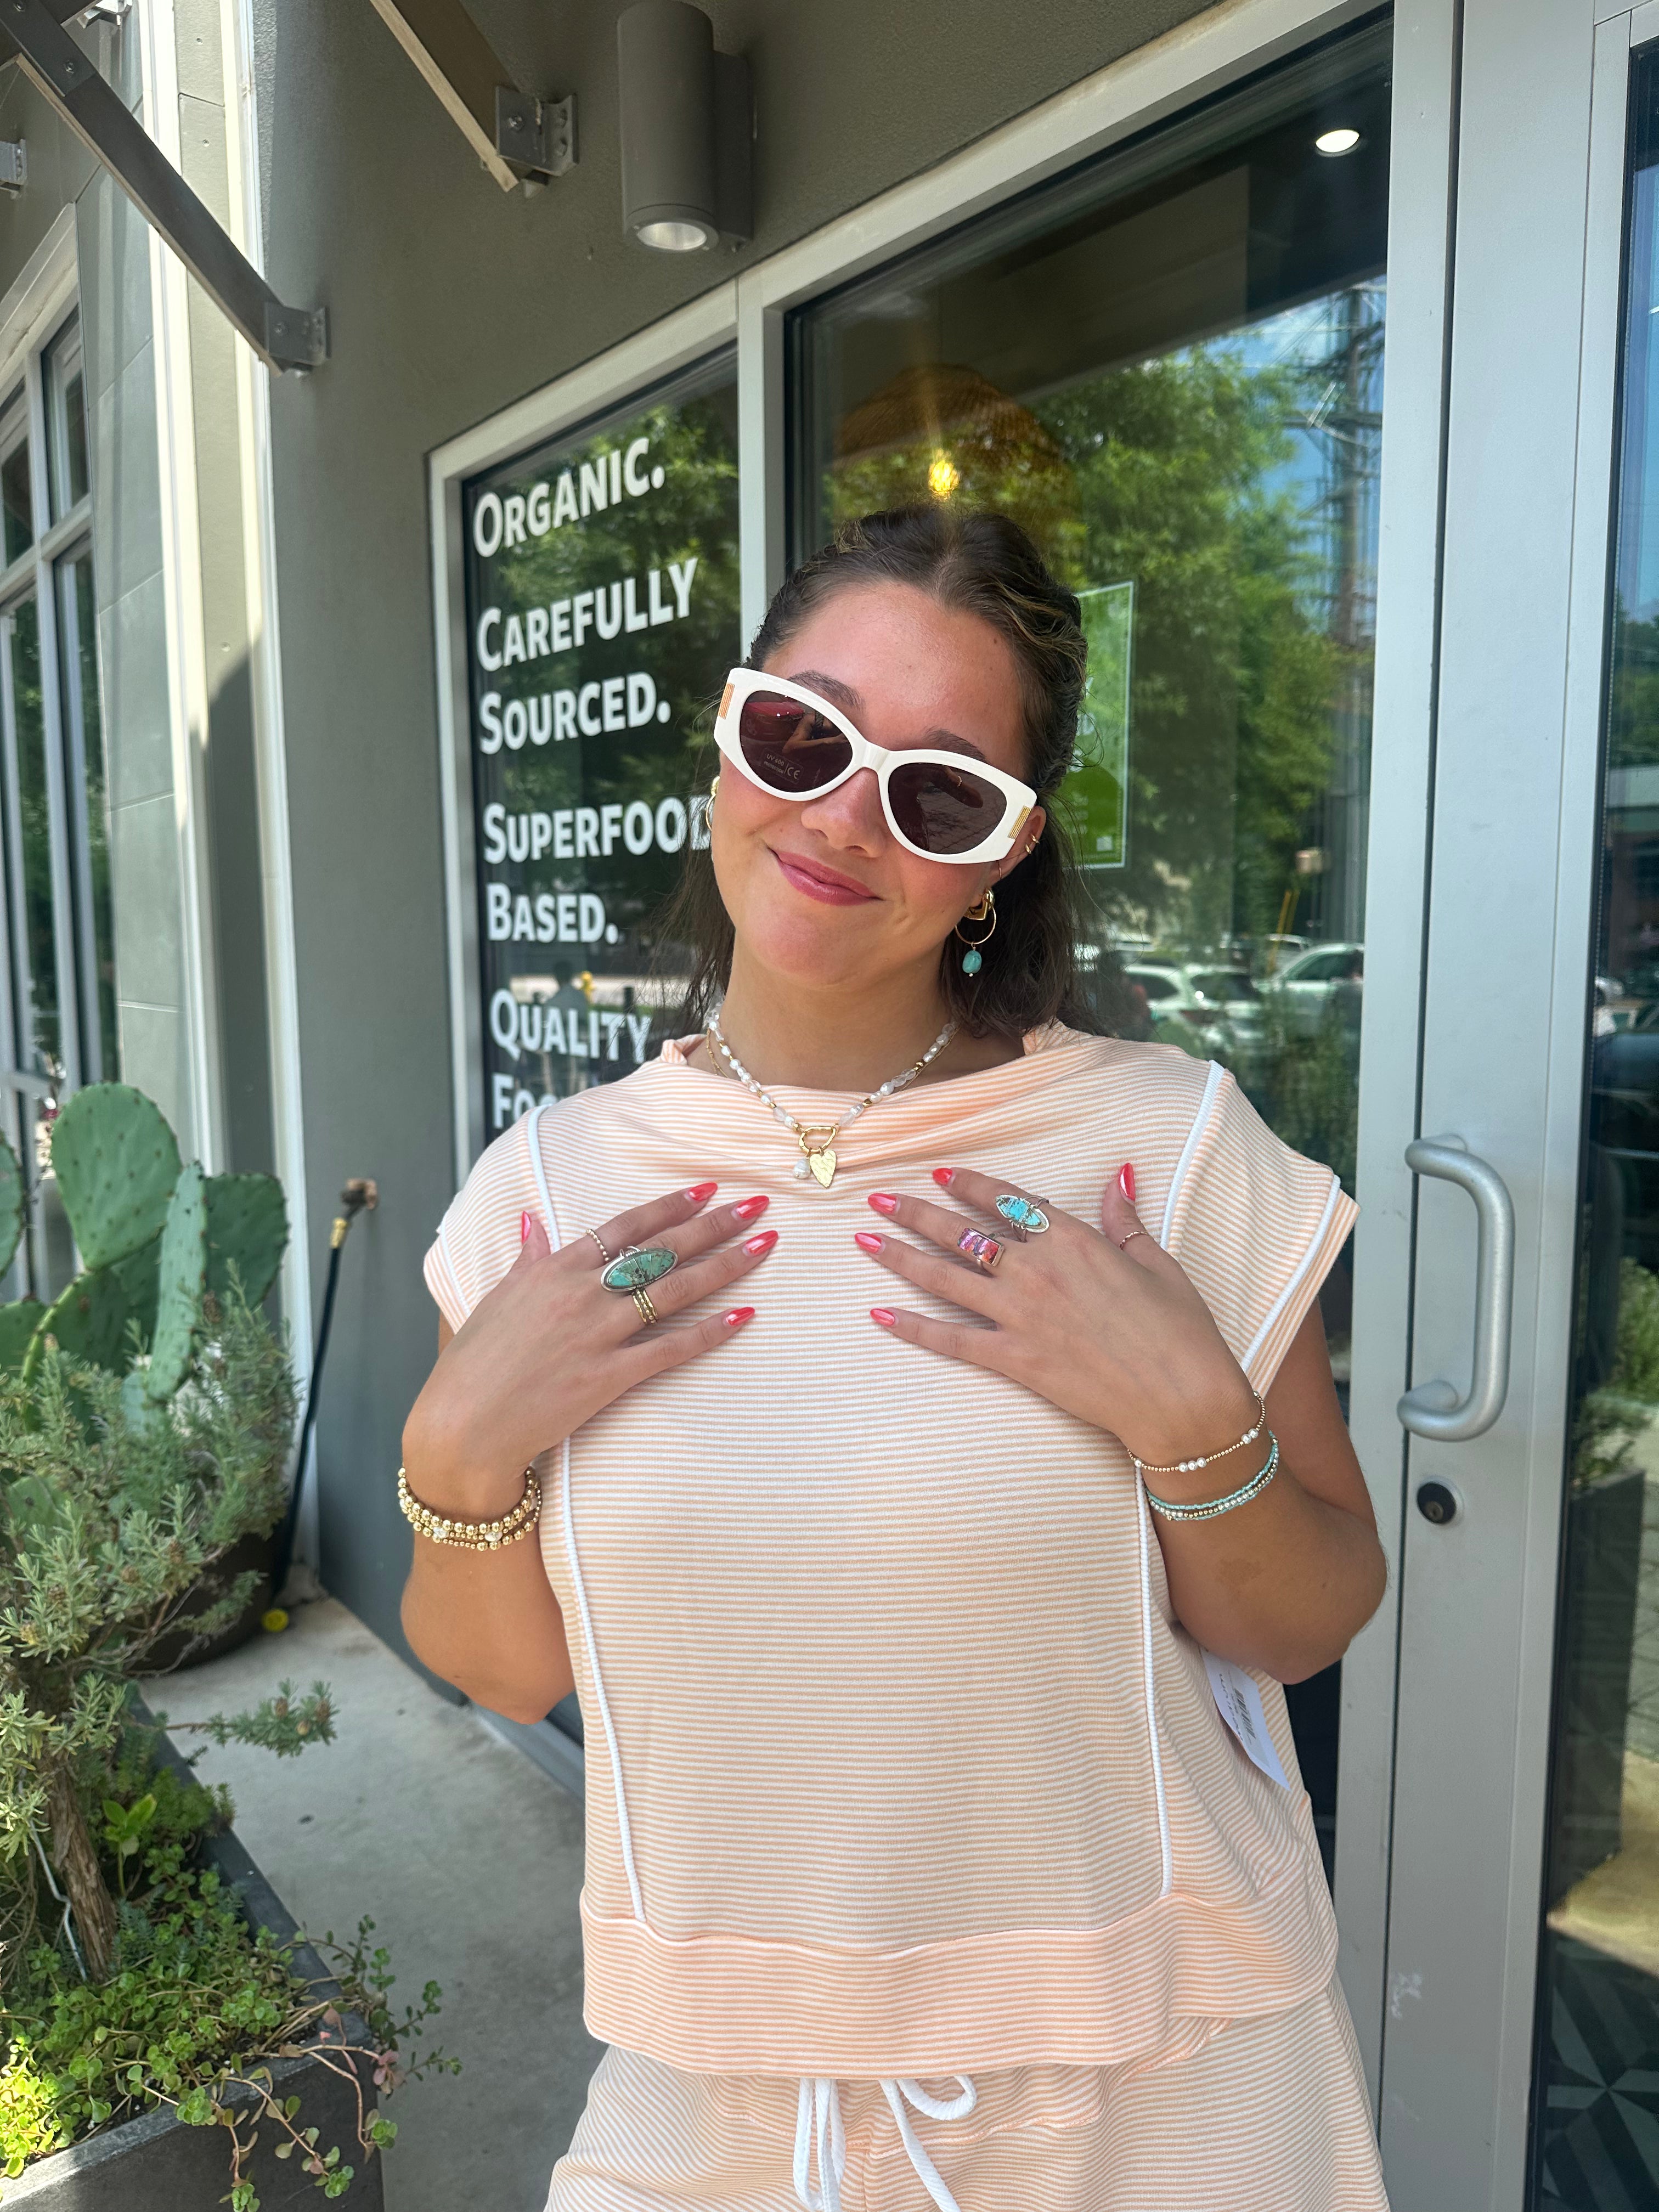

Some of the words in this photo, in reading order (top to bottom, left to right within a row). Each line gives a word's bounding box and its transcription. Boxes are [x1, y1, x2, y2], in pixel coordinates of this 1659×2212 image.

[473, 437, 665, 558] ORGANIC.
[477, 557, 698, 672] CAREFULLY
[479, 671, 672, 755] SOURCED.
[787, 767, 800, 780] CE
[483, 794, 713, 865] SUPERFOOD
[486, 882, 619, 945] BASED.
[489, 989, 653, 1064] QUALITY
[492, 1071, 558, 1130] FO
